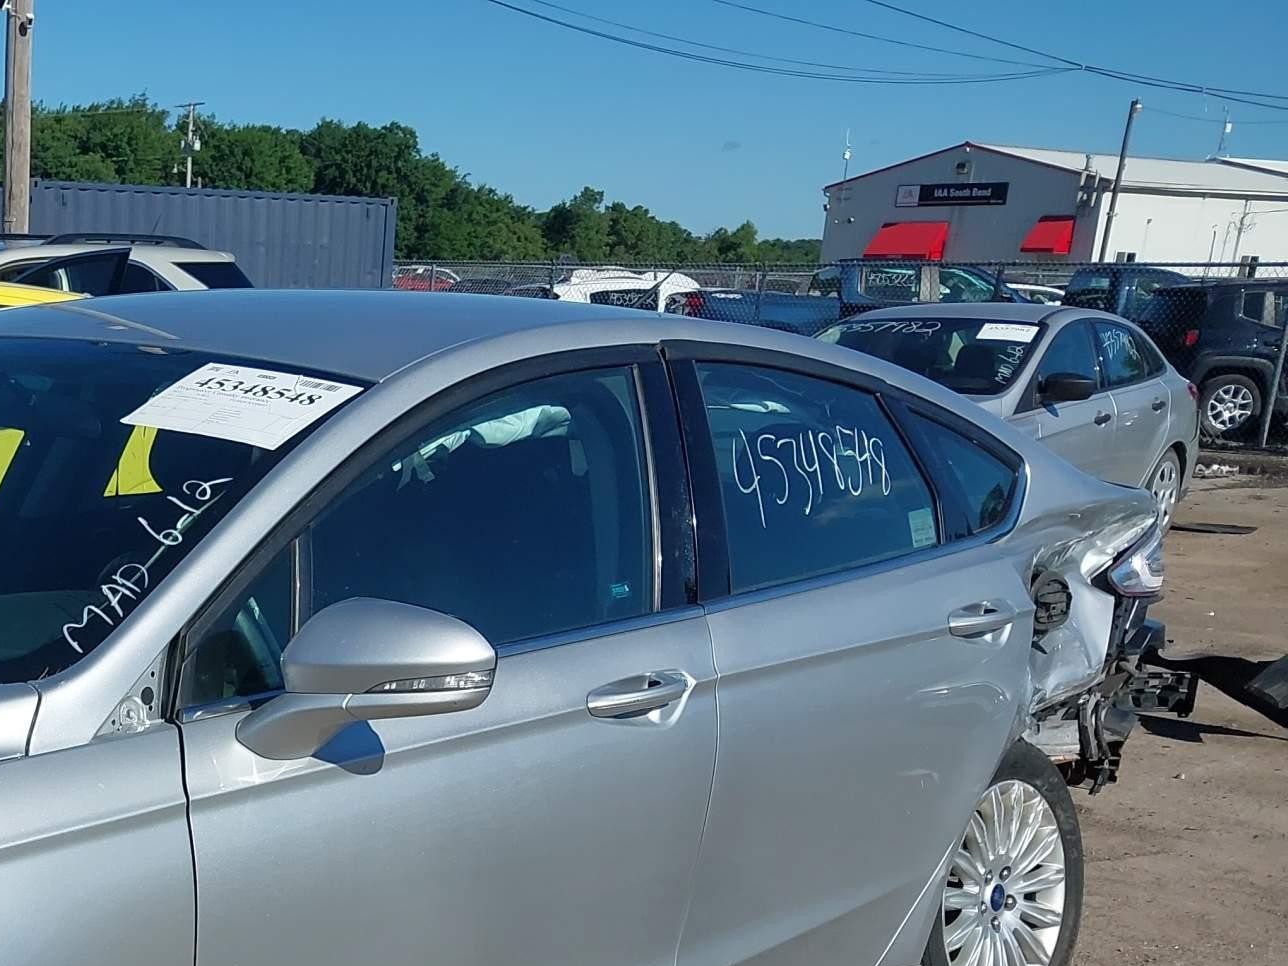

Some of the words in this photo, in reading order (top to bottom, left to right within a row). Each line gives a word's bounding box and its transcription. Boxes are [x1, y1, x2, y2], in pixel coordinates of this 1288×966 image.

[194, 376, 323, 406] 45348548
[733, 425, 891, 528] 45348548
[62, 563, 149, 654] MAD
[137, 477, 235, 546] 6-12
